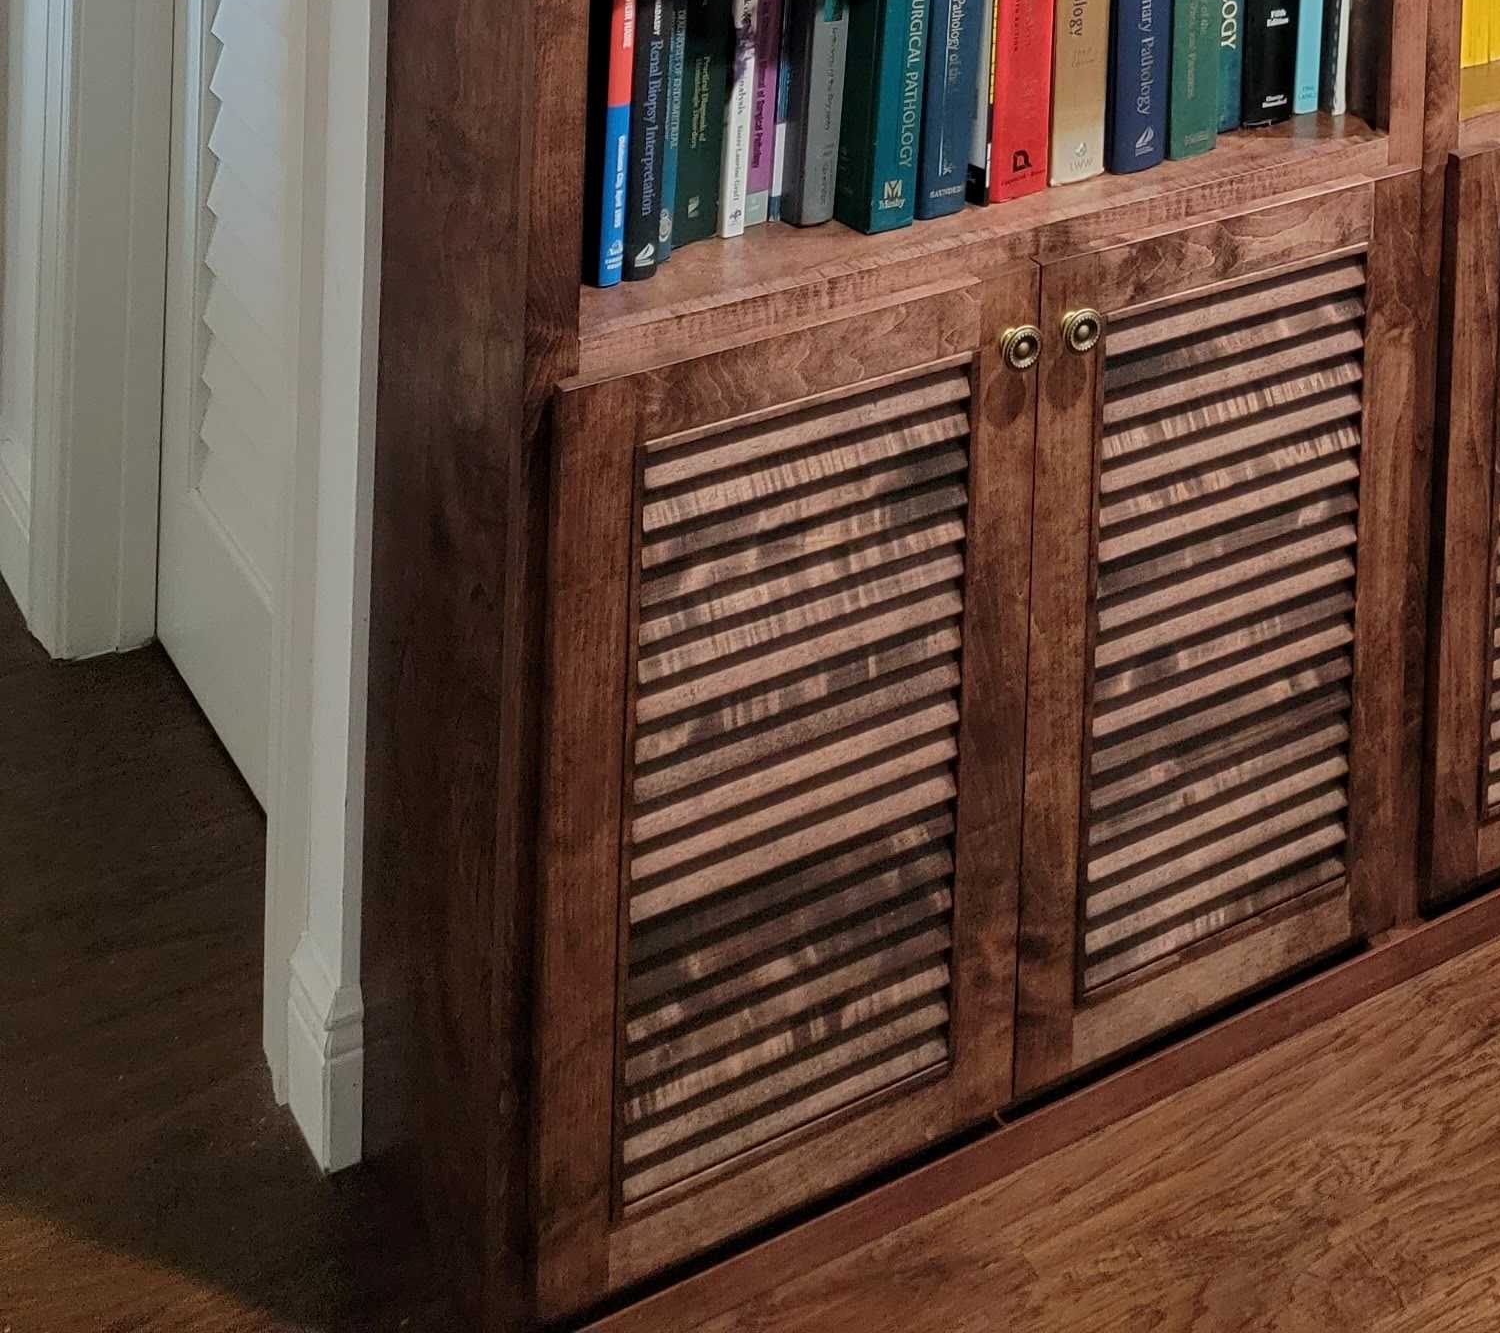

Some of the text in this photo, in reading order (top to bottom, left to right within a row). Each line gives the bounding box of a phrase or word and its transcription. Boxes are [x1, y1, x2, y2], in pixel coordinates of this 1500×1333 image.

[899, 71, 919, 168] PATHOLOGY
[1136, 36, 1154, 116] Pathology
[641, 40, 664, 216] Renal Biopsy Interpretation
